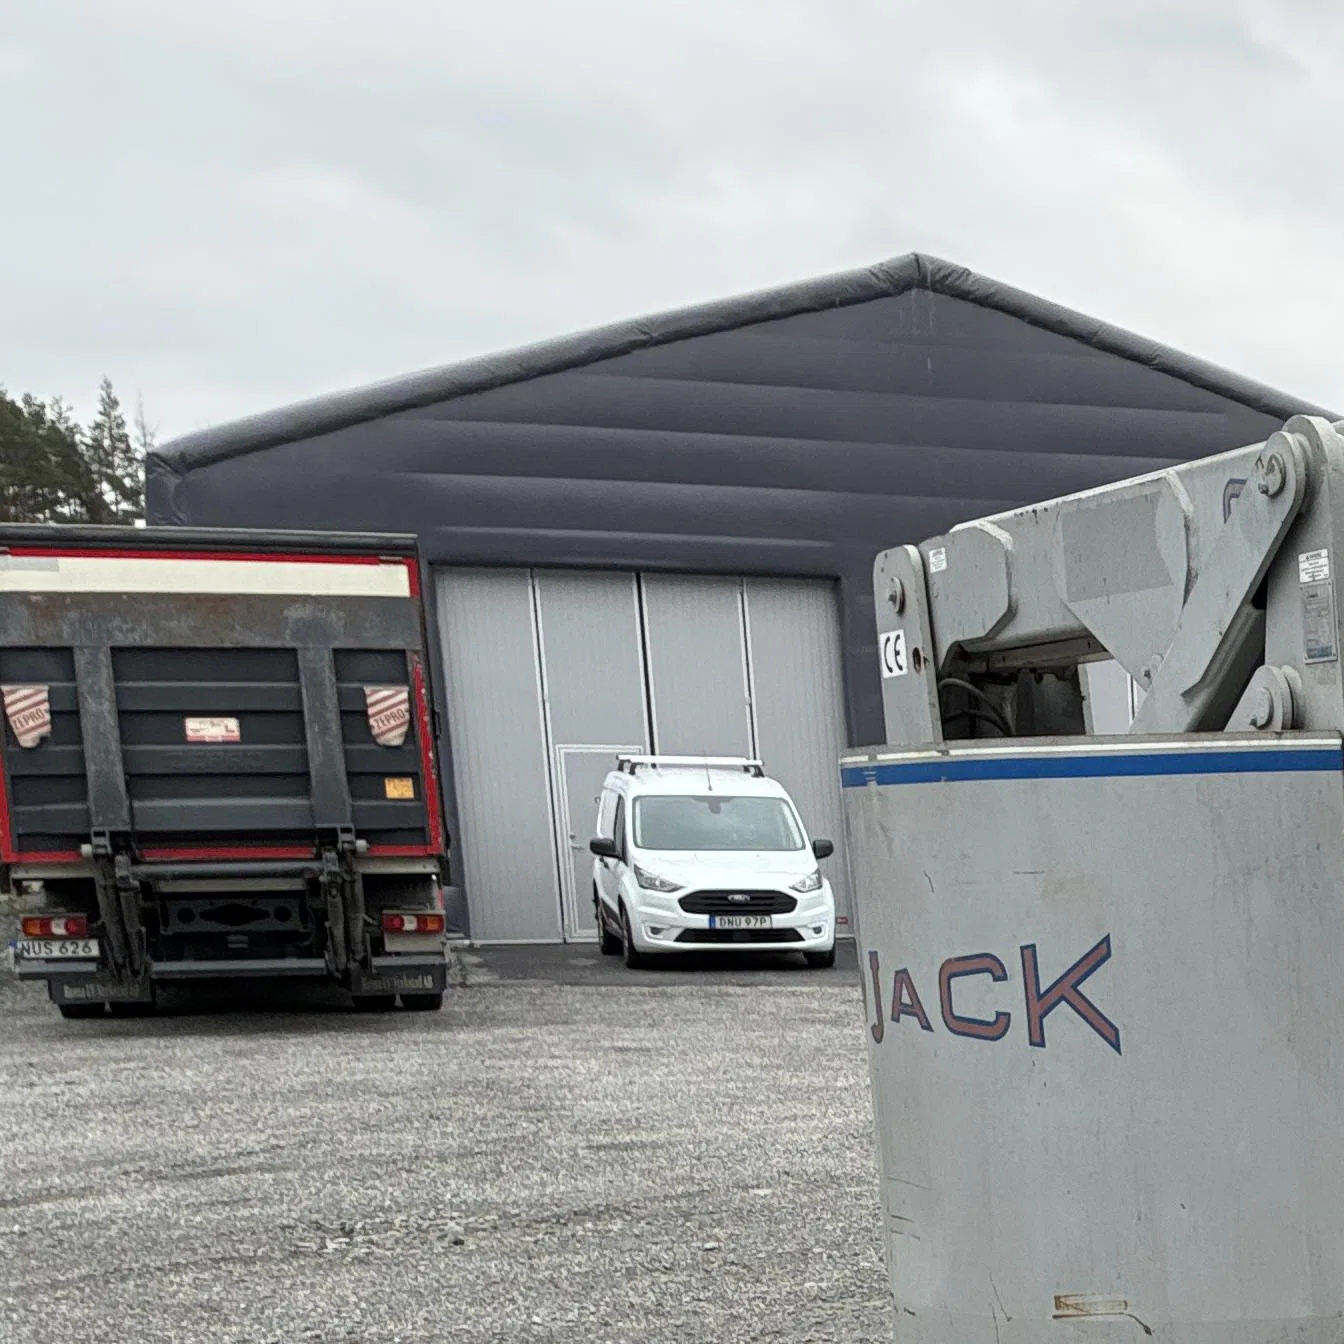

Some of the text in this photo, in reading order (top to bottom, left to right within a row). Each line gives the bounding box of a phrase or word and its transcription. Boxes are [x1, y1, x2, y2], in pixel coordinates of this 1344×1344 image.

[719, 915, 767, 928] DNU 97P
[21, 940, 93, 956] NUS 626
[868, 932, 1123, 1056] JACK
